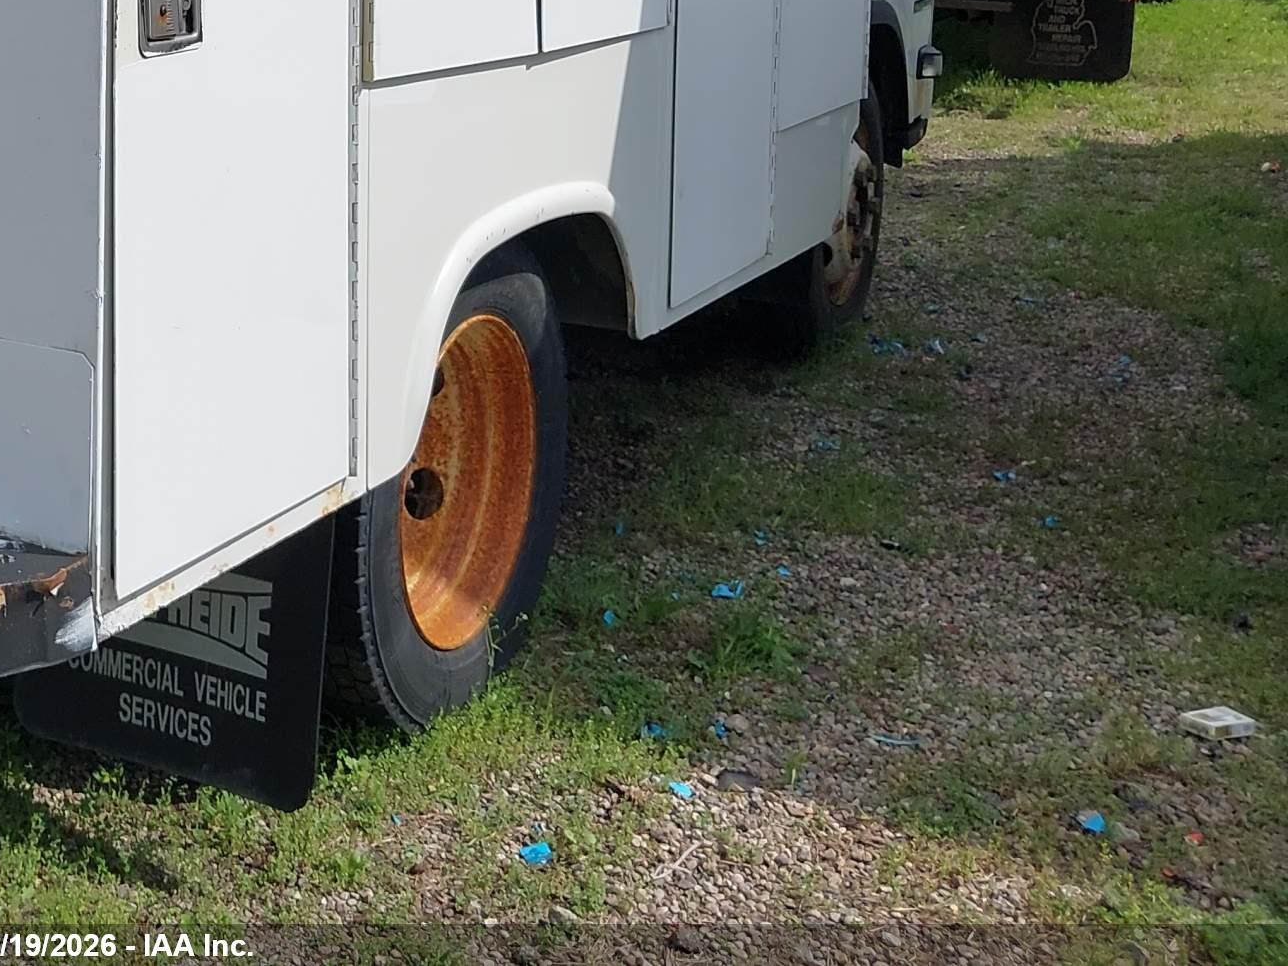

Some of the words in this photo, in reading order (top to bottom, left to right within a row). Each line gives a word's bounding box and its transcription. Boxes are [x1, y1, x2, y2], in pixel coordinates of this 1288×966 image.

[154, 590, 271, 666] HEIDE
[119, 692, 212, 746] SERVICES
[194, 671, 268, 722] VEHICLE
